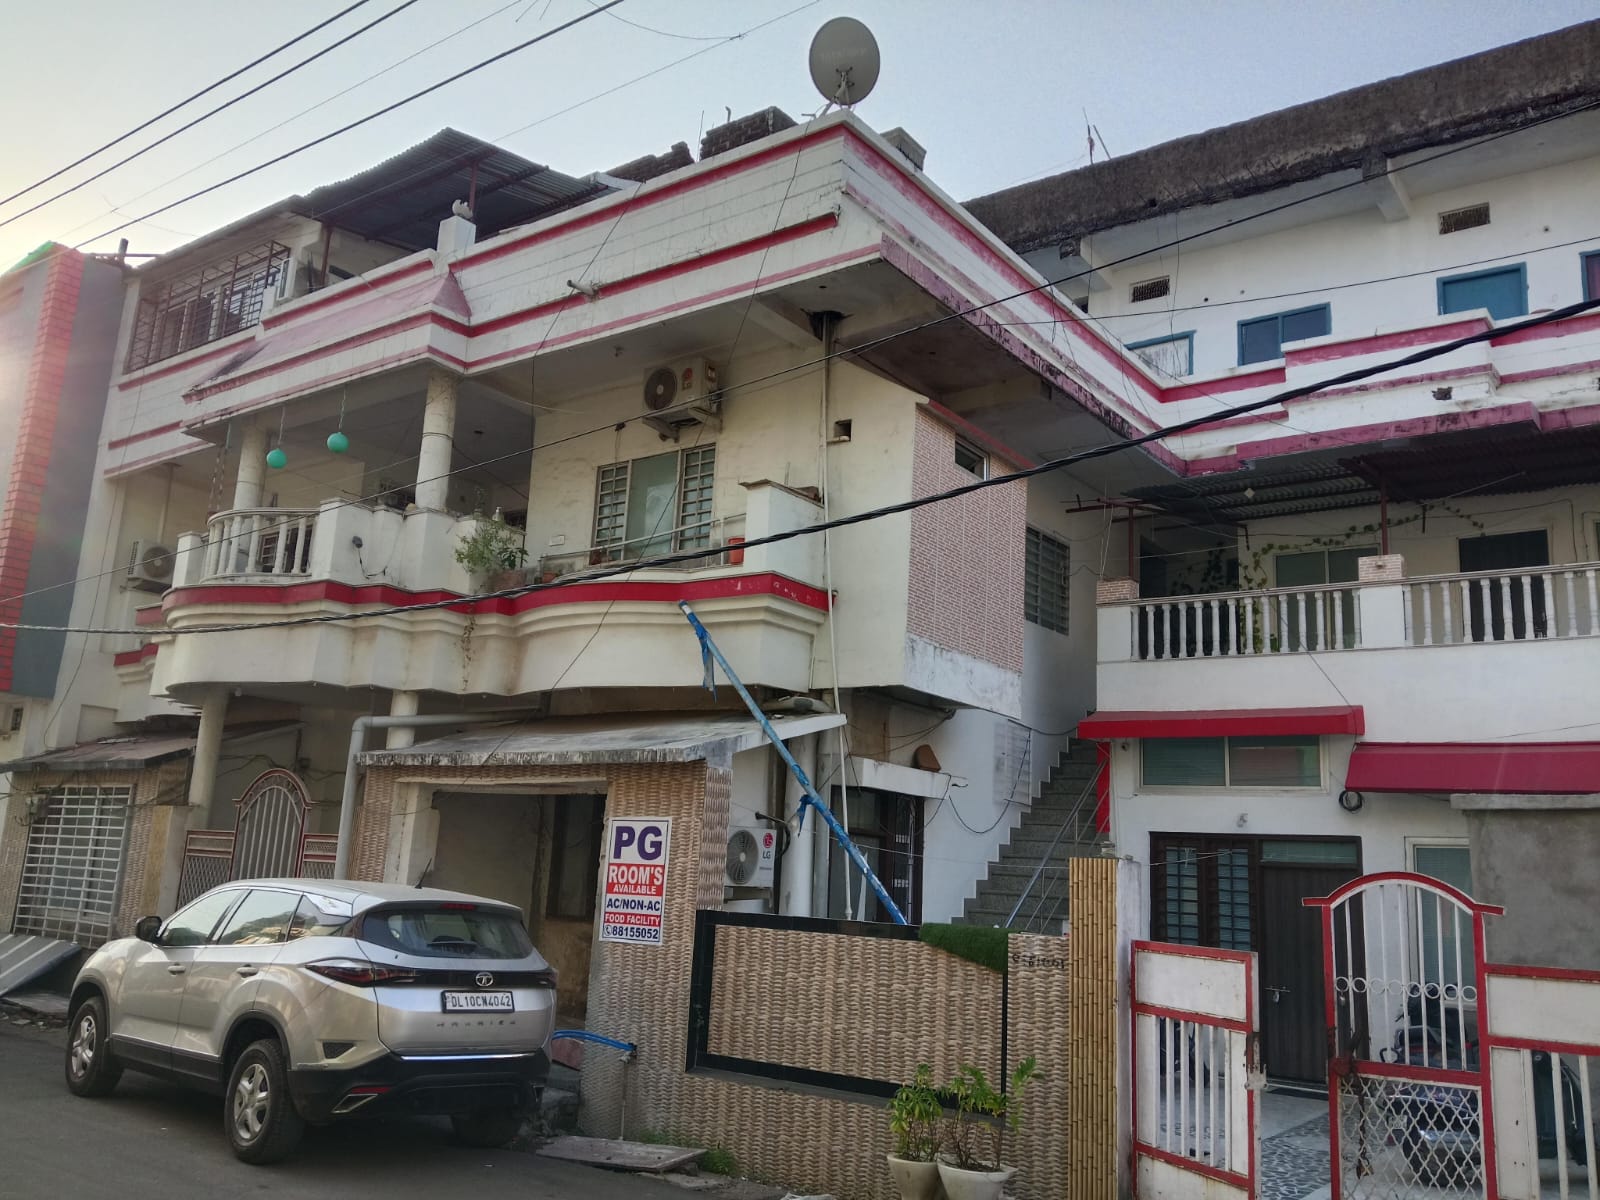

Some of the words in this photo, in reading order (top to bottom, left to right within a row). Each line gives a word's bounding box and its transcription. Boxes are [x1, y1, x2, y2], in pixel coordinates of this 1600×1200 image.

[613, 825, 663, 861] PG
[762, 850, 771, 859] LG
[608, 865, 663, 886] ROOM'S
[613, 884, 656, 895] AVAILABLE
[606, 898, 660, 912] AC/NON-AC
[605, 913, 625, 923] FOOD
[626, 914, 660, 926] FACILITY
[612, 926, 659, 940] 88155052
